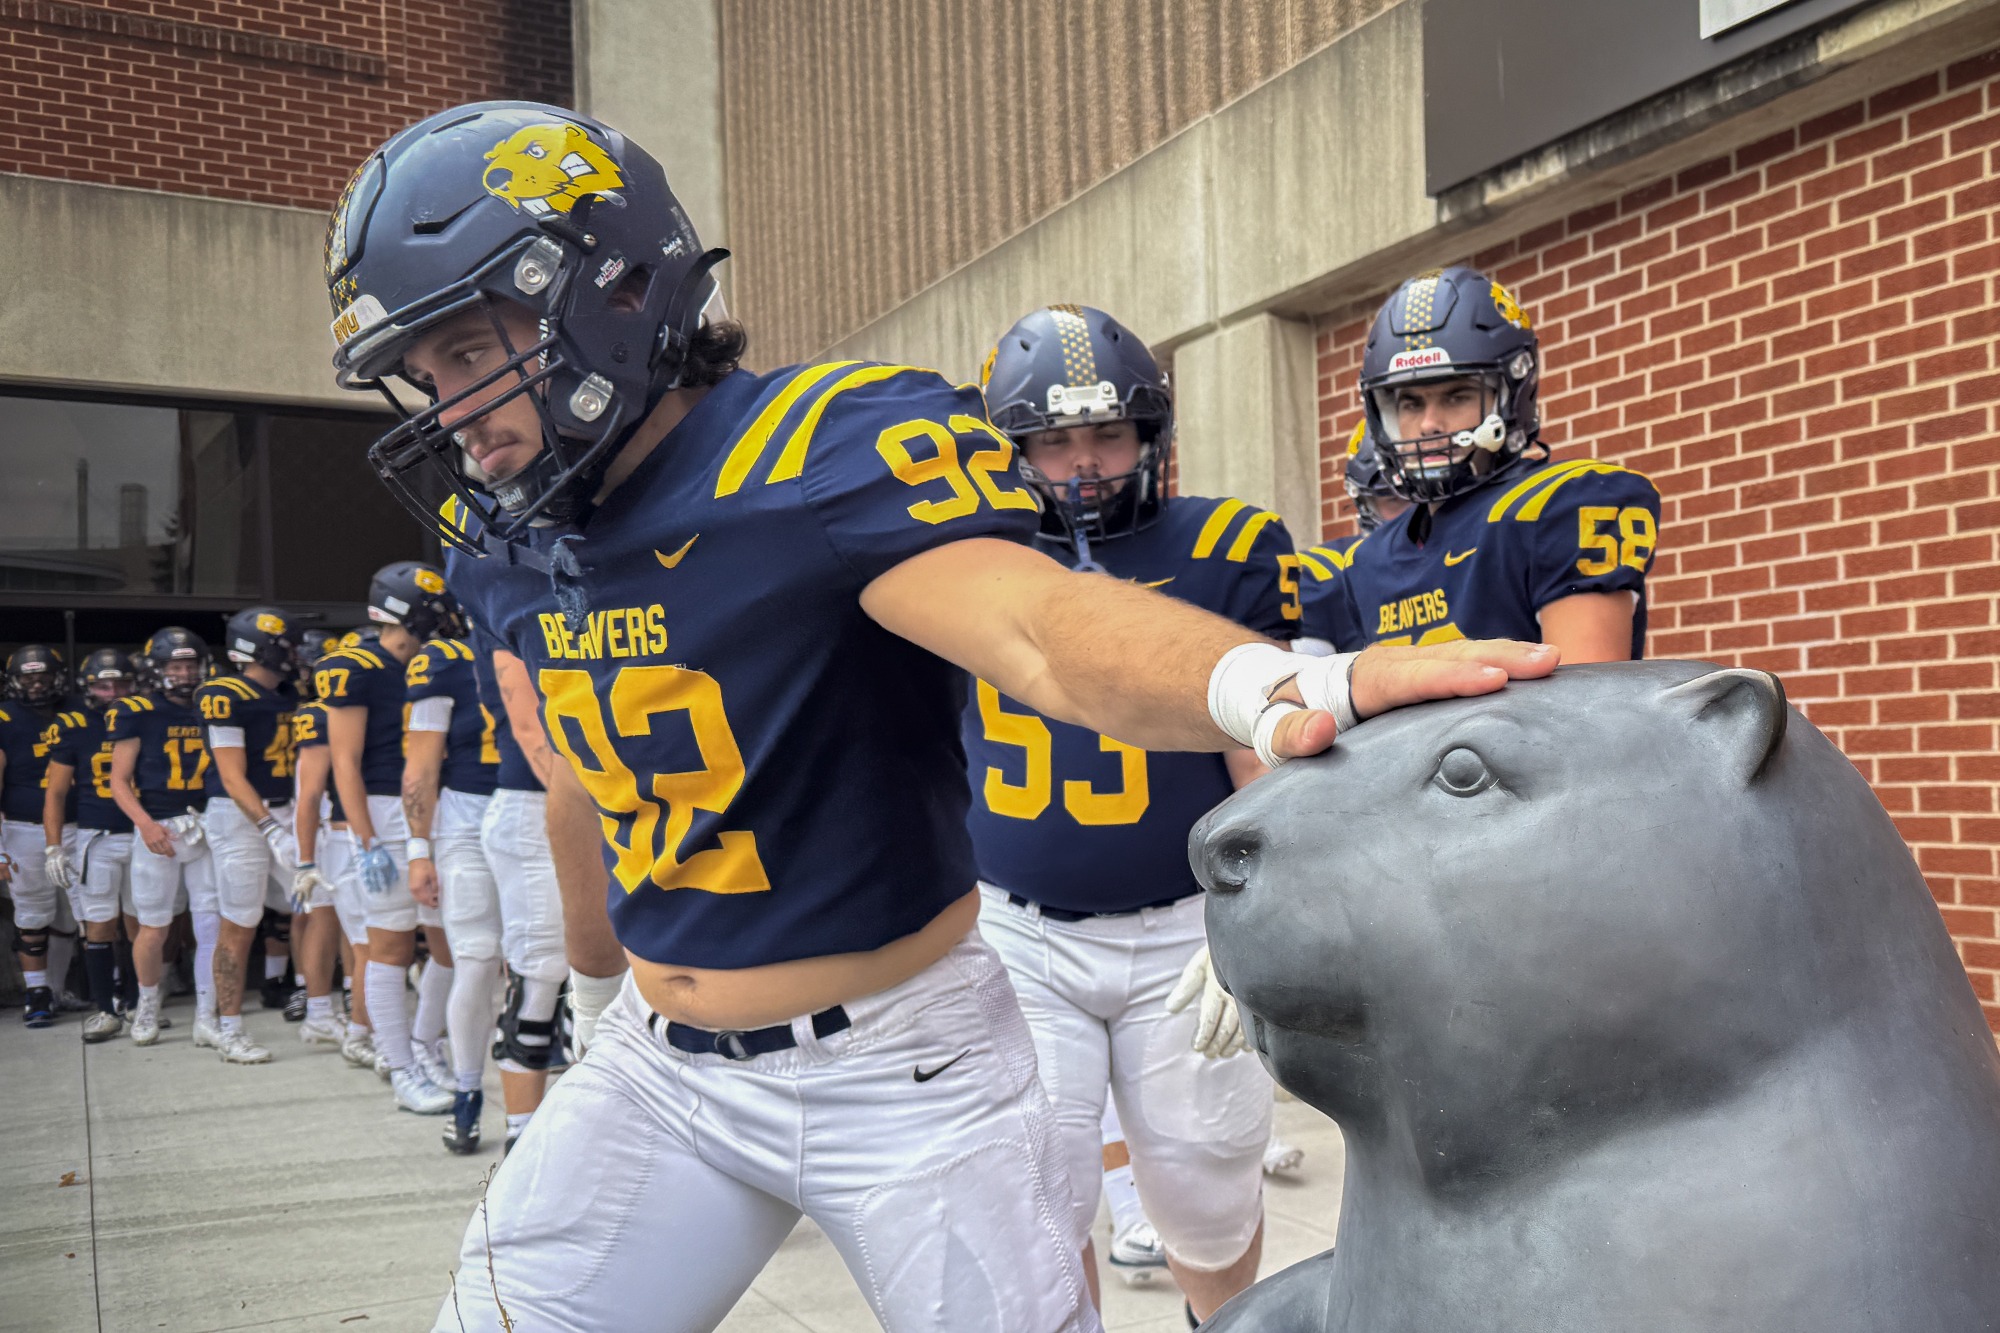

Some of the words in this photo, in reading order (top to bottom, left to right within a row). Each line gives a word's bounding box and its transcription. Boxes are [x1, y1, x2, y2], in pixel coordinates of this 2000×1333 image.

[1395, 352, 1441, 368] Riddell
[876, 414, 1038, 525] 92
[1576, 506, 1658, 576] 58
[1276, 555, 1303, 621] 5
[1377, 588, 1448, 634] BEAVERS
[539, 604, 668, 659] BEAVERS
[315, 661, 350, 698] 87
[200, 695, 231, 719] 40
[163, 738, 211, 790] 17
[539, 664, 771, 895] 92
